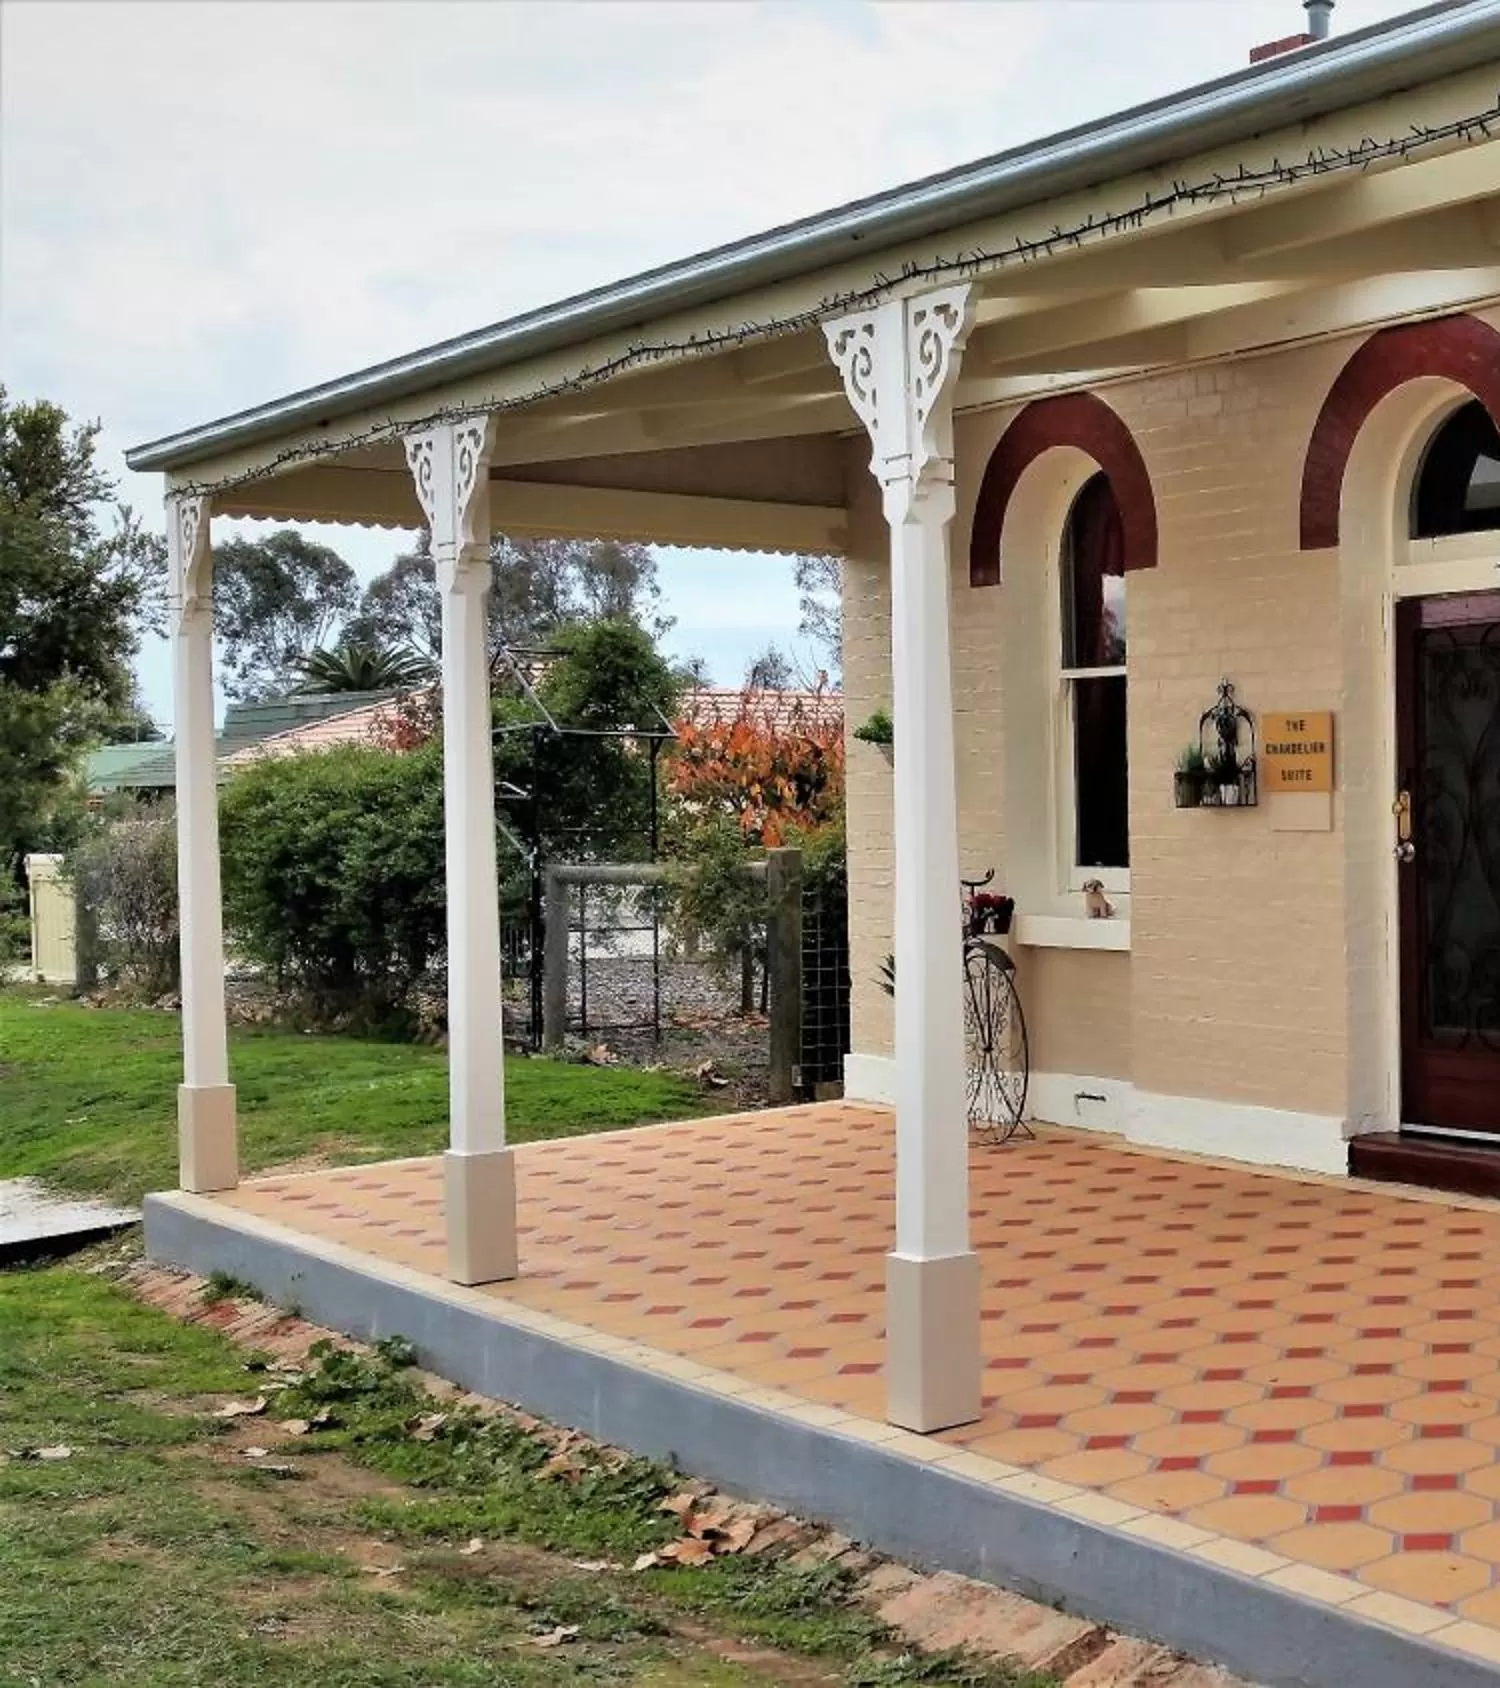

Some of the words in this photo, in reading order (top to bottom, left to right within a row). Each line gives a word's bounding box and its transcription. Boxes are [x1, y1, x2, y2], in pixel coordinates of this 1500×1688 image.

[1285, 719, 1306, 732] THE
[1265, 741, 1326, 755] CHANDELIER
[1281, 769, 1312, 782] SUITE
